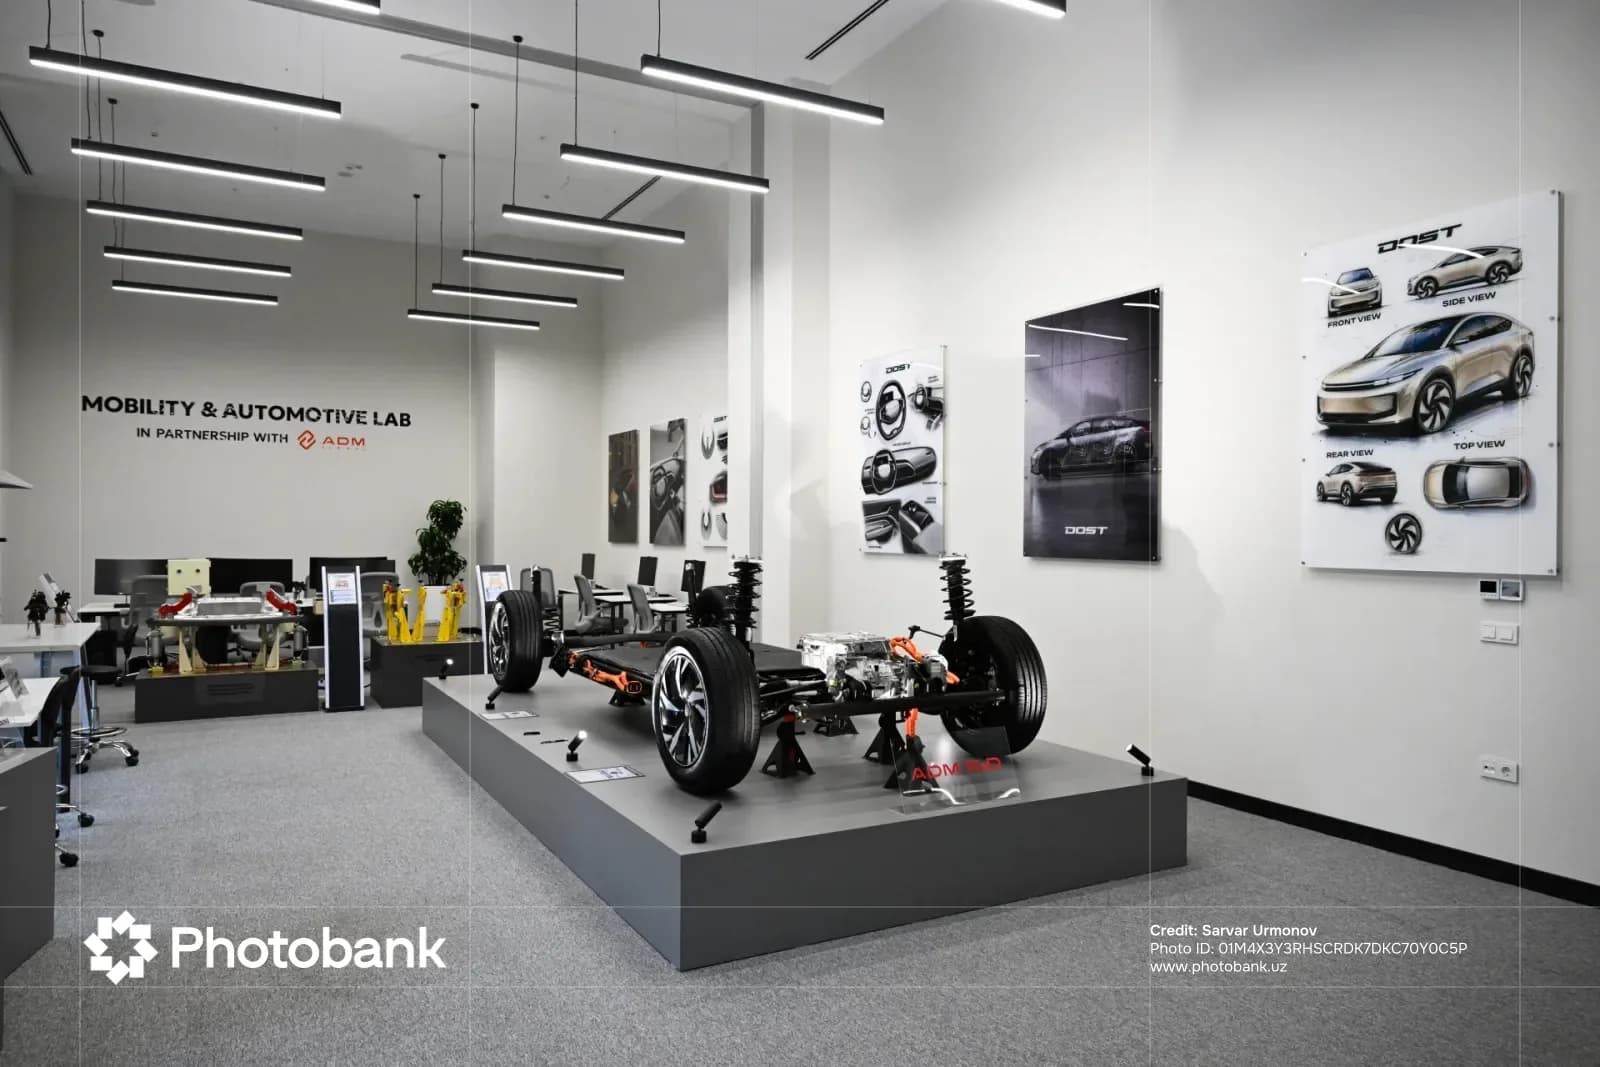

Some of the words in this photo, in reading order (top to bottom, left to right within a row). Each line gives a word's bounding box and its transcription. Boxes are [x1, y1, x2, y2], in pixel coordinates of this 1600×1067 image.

[1377, 223, 1463, 254] DOST
[1442, 297, 1465, 307] SIDE
[1468, 291, 1497, 303] VIEW
[1327, 317, 1355, 328] FRONT
[1357, 312, 1382, 325] VIEW
[81, 395, 195, 416] MOBILITY
[201, 401, 217, 417] &
[222, 403, 368, 425] AUTOMOTIVE
[373, 411, 411, 427] LAB
[136, 427, 151, 438] IN
[156, 428, 249, 441] PARTNERSHIP
[254, 433, 289, 443] WITH
[322, 436, 366, 446] ADM
[1454, 442, 1475, 450] TOP
[1476, 440, 1506, 449] VIEW
[1326, 450, 1349, 459] REAR
[1350, 449, 1374, 458] VIEW
[1064, 526, 1109, 535] DOST
[911, 762, 961, 781] ADM
